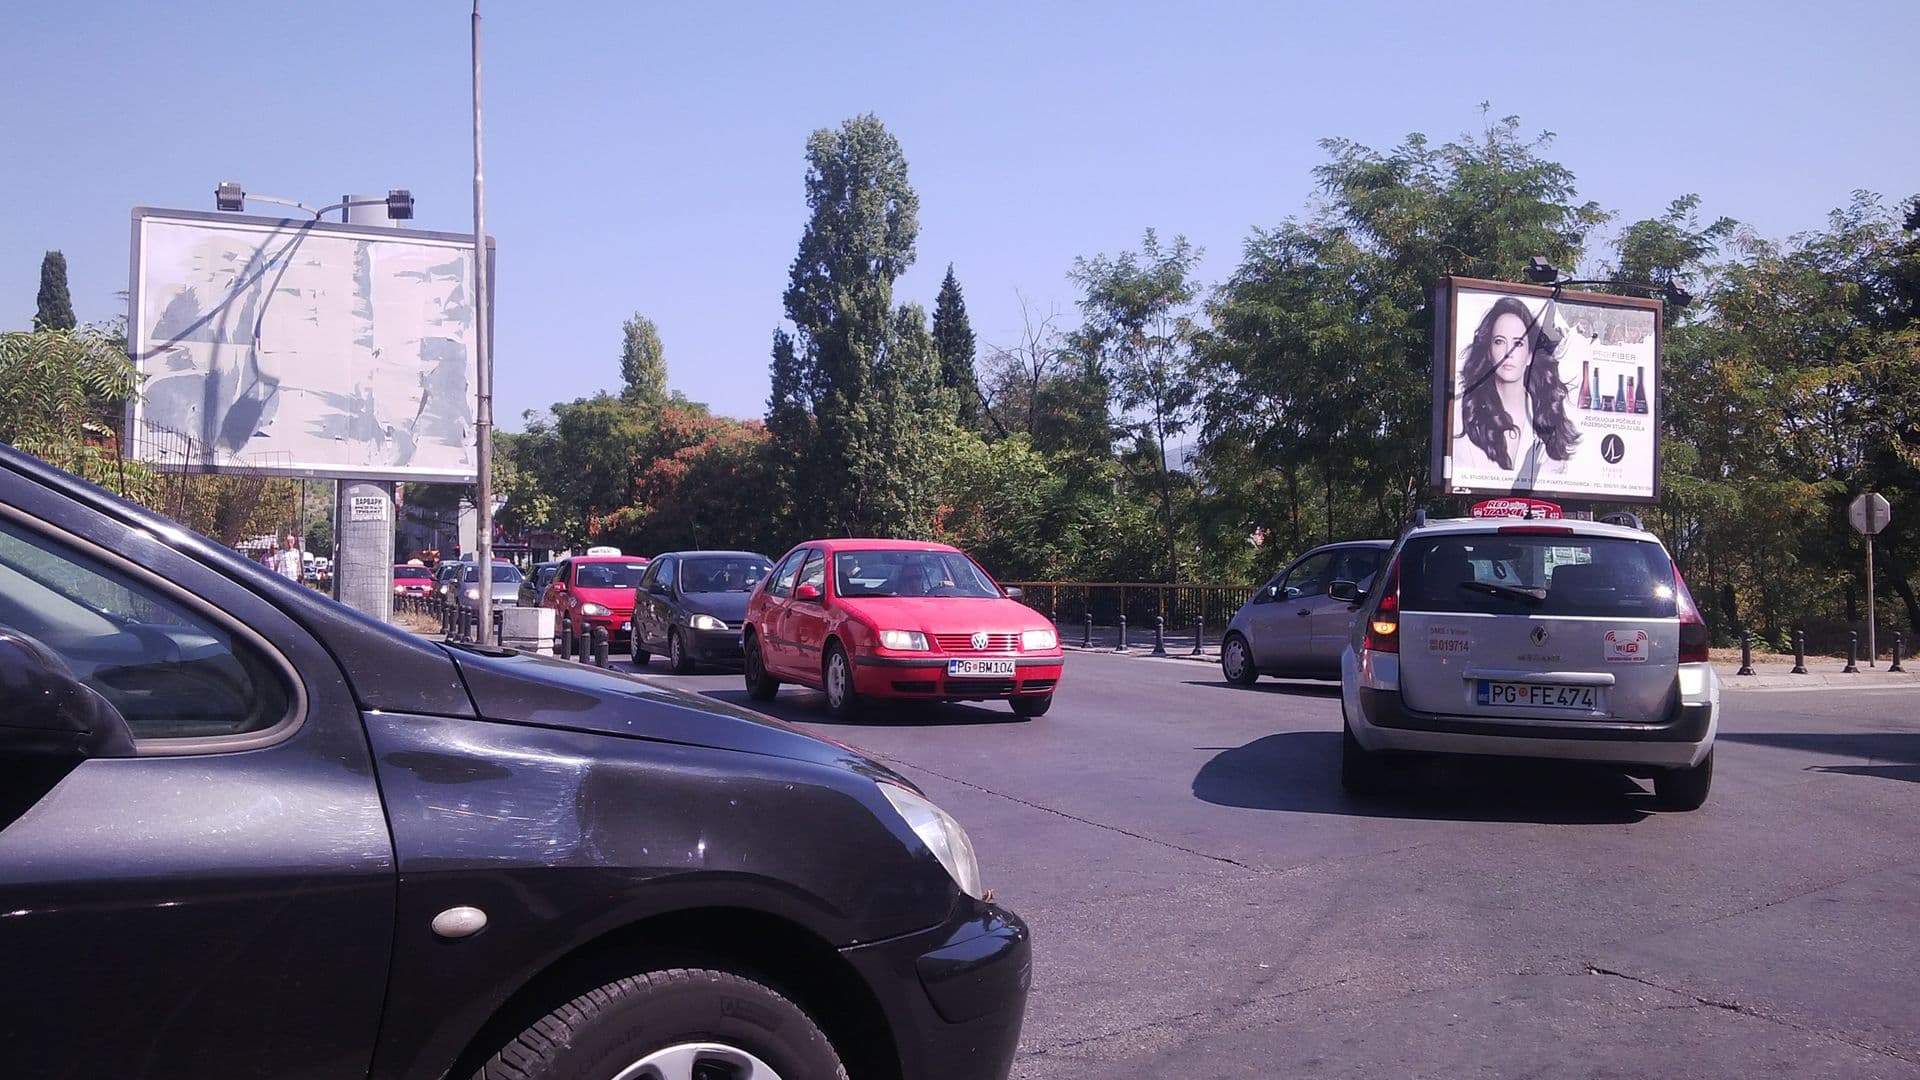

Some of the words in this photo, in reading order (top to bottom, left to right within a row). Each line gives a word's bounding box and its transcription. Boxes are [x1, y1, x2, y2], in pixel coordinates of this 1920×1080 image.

[1487, 500, 1509, 509] RED
[1438, 639, 1470, 652] 019714
[957, 661, 972, 673] PG
[978, 661, 1013, 674] BM104
[1492, 684, 1517, 703] PG
[1530, 686, 1593, 707] FE474
